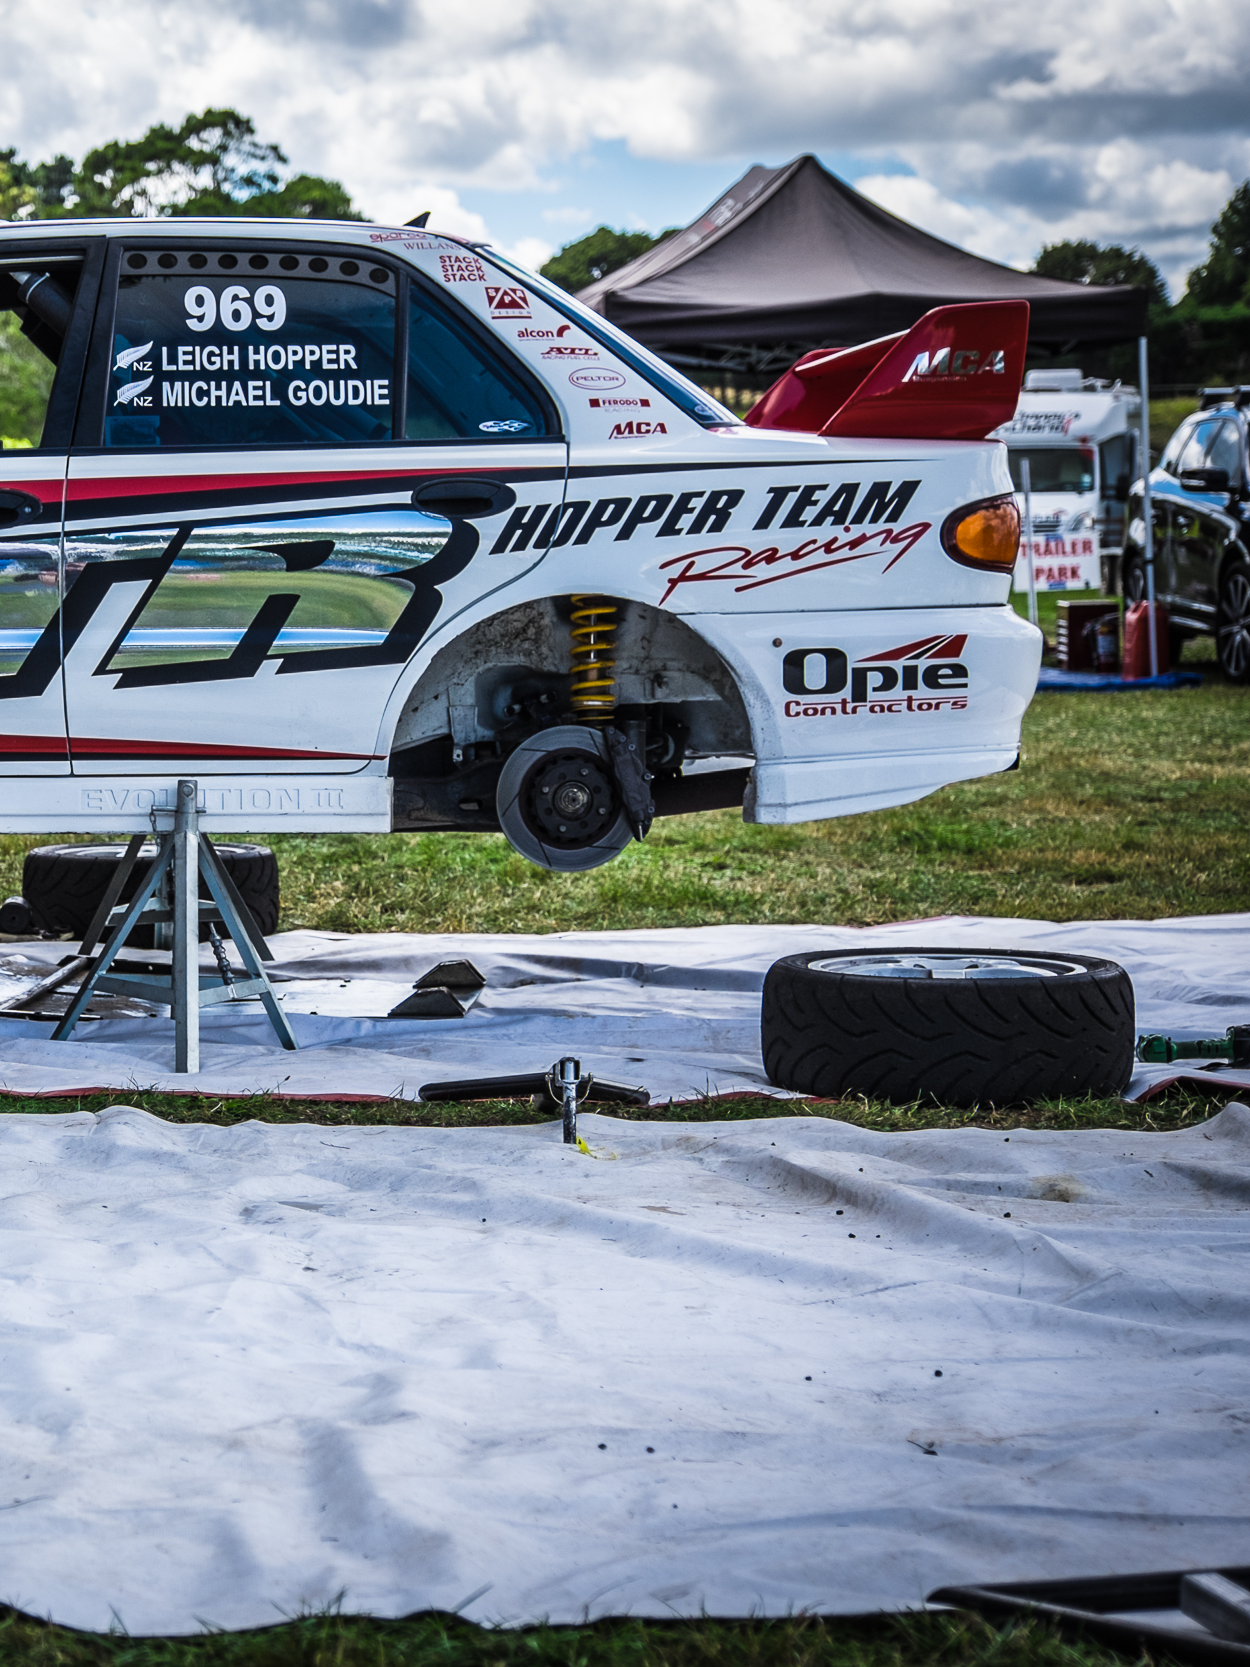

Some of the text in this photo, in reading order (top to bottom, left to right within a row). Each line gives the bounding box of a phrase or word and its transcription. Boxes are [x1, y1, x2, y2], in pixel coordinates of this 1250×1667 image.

[404, 242, 461, 250] WILLANS
[439, 255, 481, 264] STACK
[441, 264, 485, 273] STACK
[443, 273, 487, 282] STACK
[184, 285, 287, 331] 969
[517, 328, 555, 338] alcon
[133, 344, 358, 371] NZ LEIGH HOPPER
[901, 347, 1005, 382] MCA
[133, 379, 390, 406] NZ MICHAEL GOUDIE
[608, 420, 668, 440] MCA
[489, 480, 922, 556] HOPPER TEAM
[659, 521, 932, 606] Racing
[1034, 564, 1080, 583] PARK
[782, 646, 969, 702] Opie
[784, 695, 968, 718] Contractors
